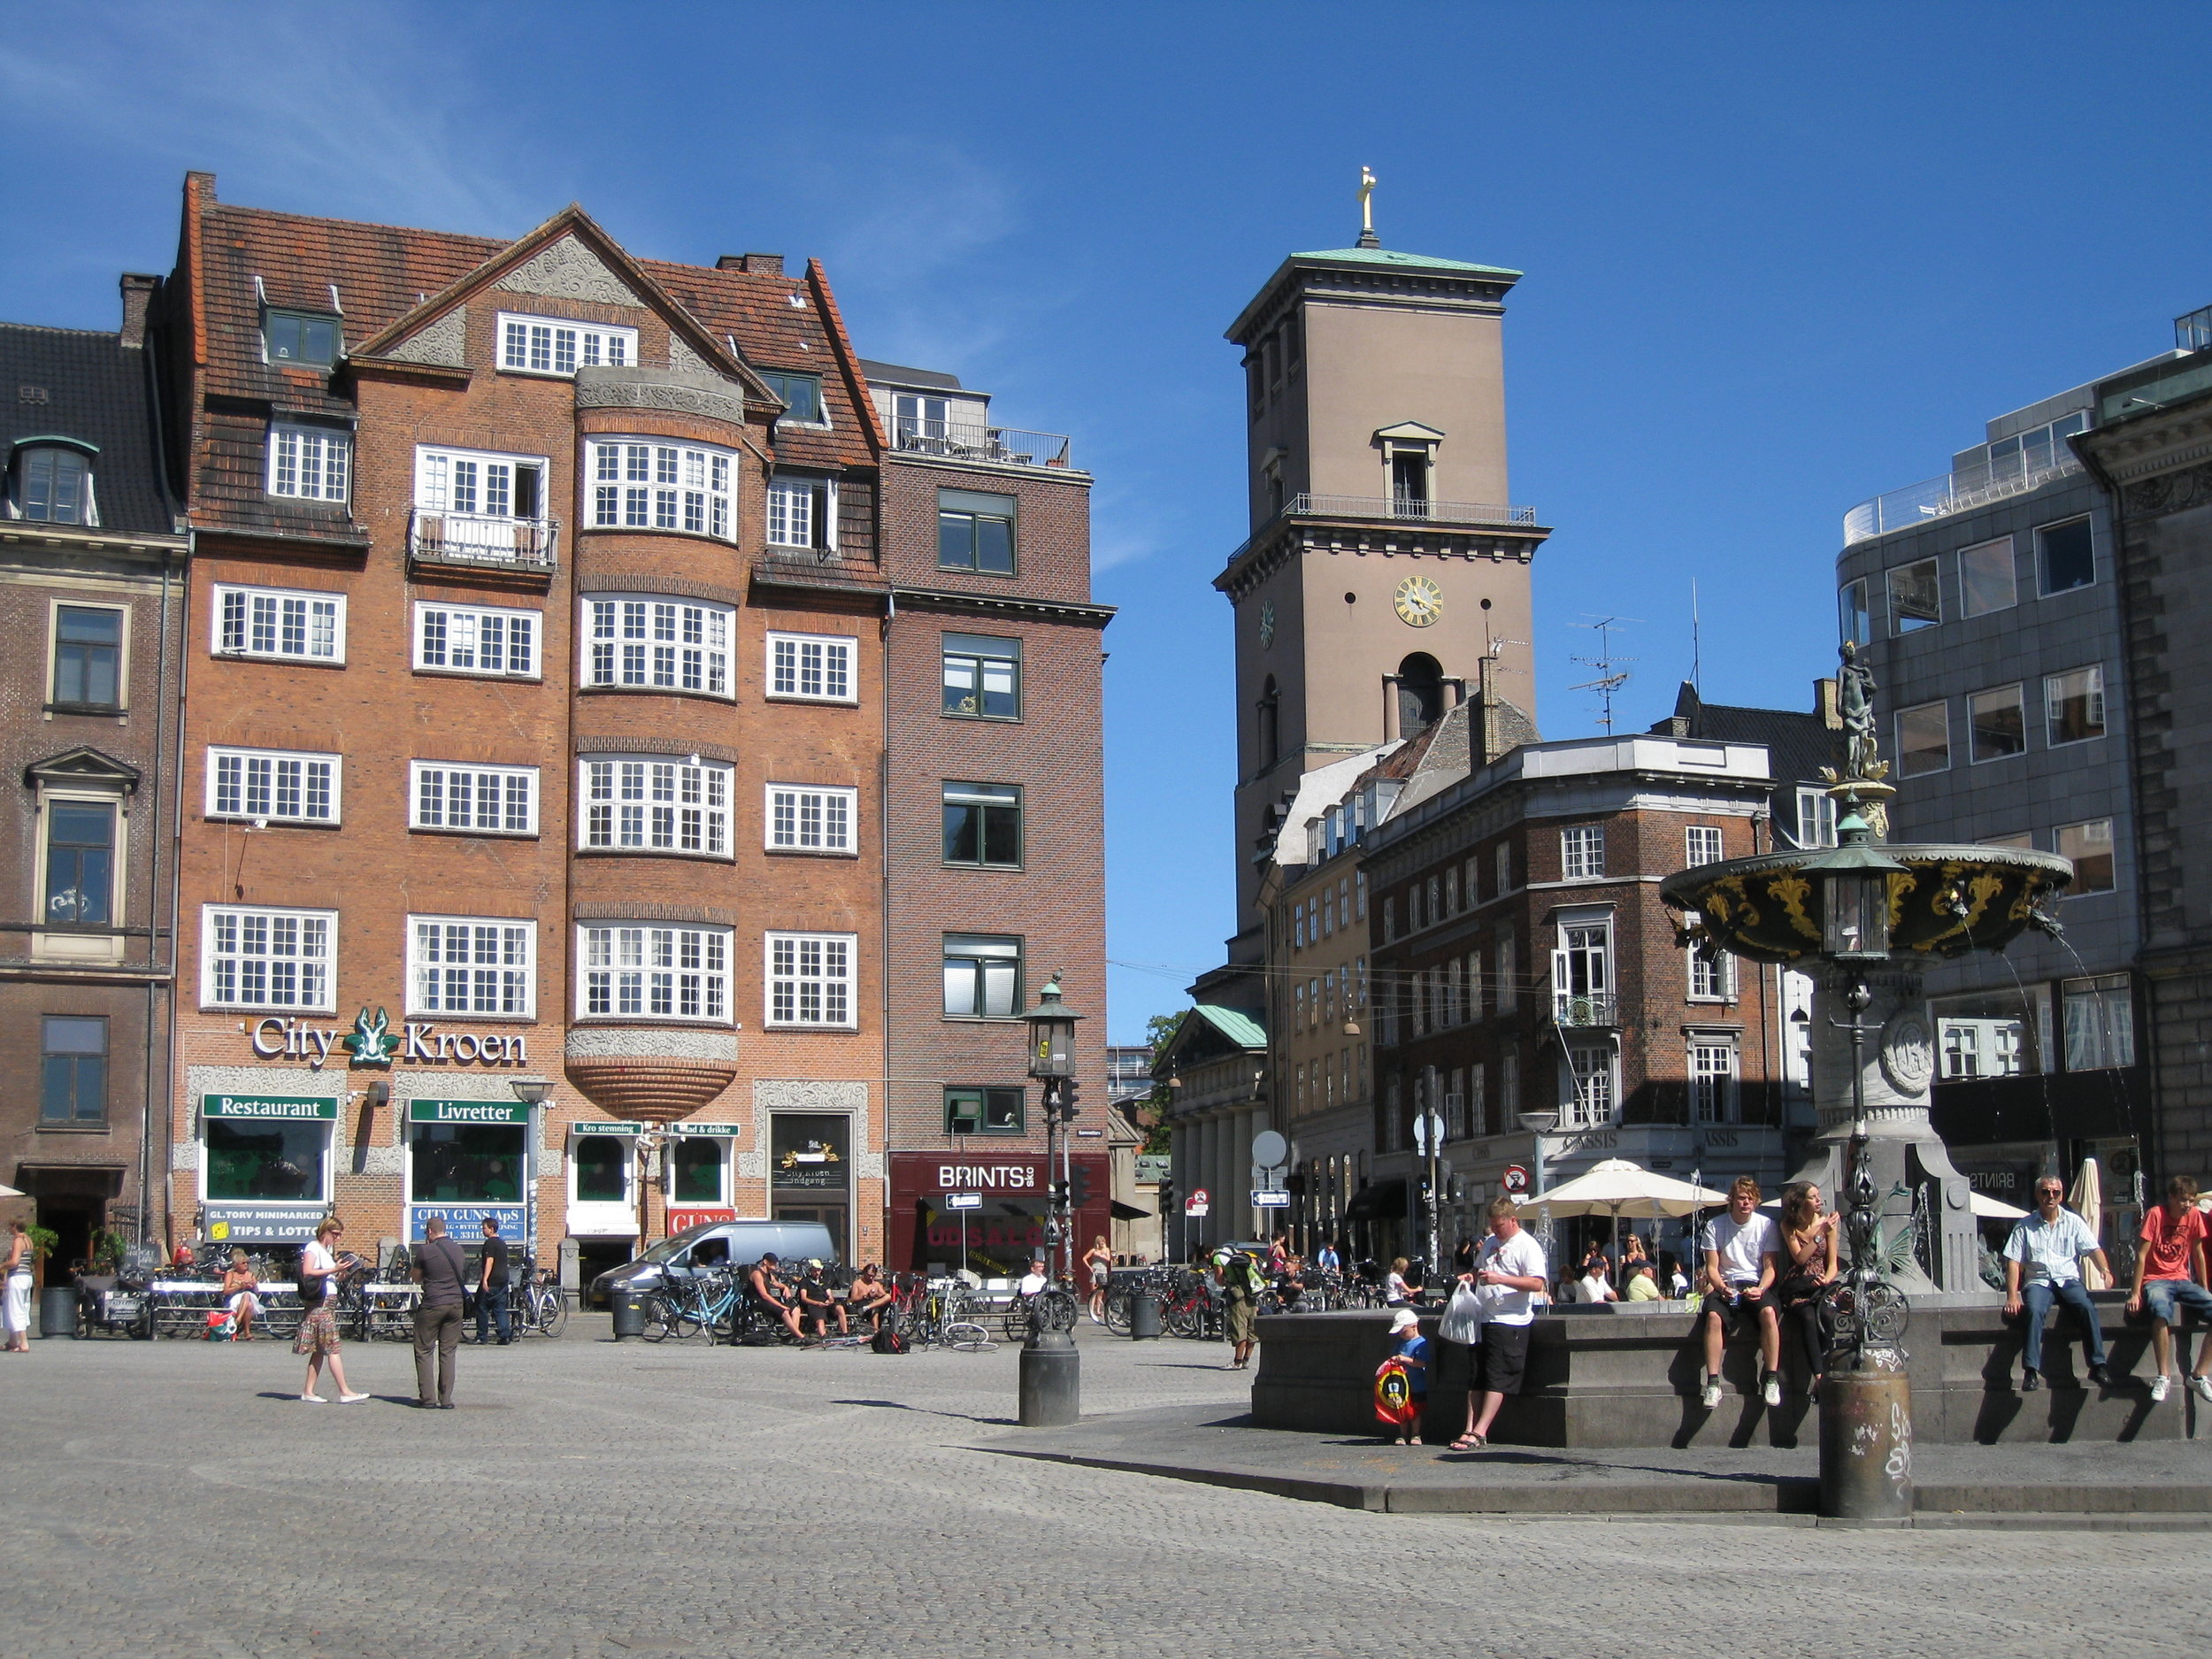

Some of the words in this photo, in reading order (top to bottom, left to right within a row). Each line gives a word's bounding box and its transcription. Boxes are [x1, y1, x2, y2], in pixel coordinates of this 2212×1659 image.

[253, 1017, 339, 1065] City
[405, 1023, 528, 1062] Kroen
[221, 1097, 321, 1118] Restaurant
[437, 1102, 513, 1121] Livretter
[582, 1124, 596, 1133] Kro
[598, 1125, 634, 1134] stemning
[707, 1125, 732, 1134] drikke
[1563, 1133, 1617, 1152] CASSIS
[939, 1165, 1025, 1188] BRINTS
[1025, 1166, 1035, 1187] sko
[210, 1210, 253, 1219] GL.TORV
[255, 1210, 324, 1219] MINIMARKED
[418, 1209, 450, 1220] CITY
[453, 1209, 490, 1221] GUNS
[495, 1209, 518, 1224] ApS
[672, 1214, 731, 1234] GU
[233, 1225, 261, 1236] TIPS
[265, 1225, 274, 1236] &
[927, 1225, 1044, 1247] UDSALG
